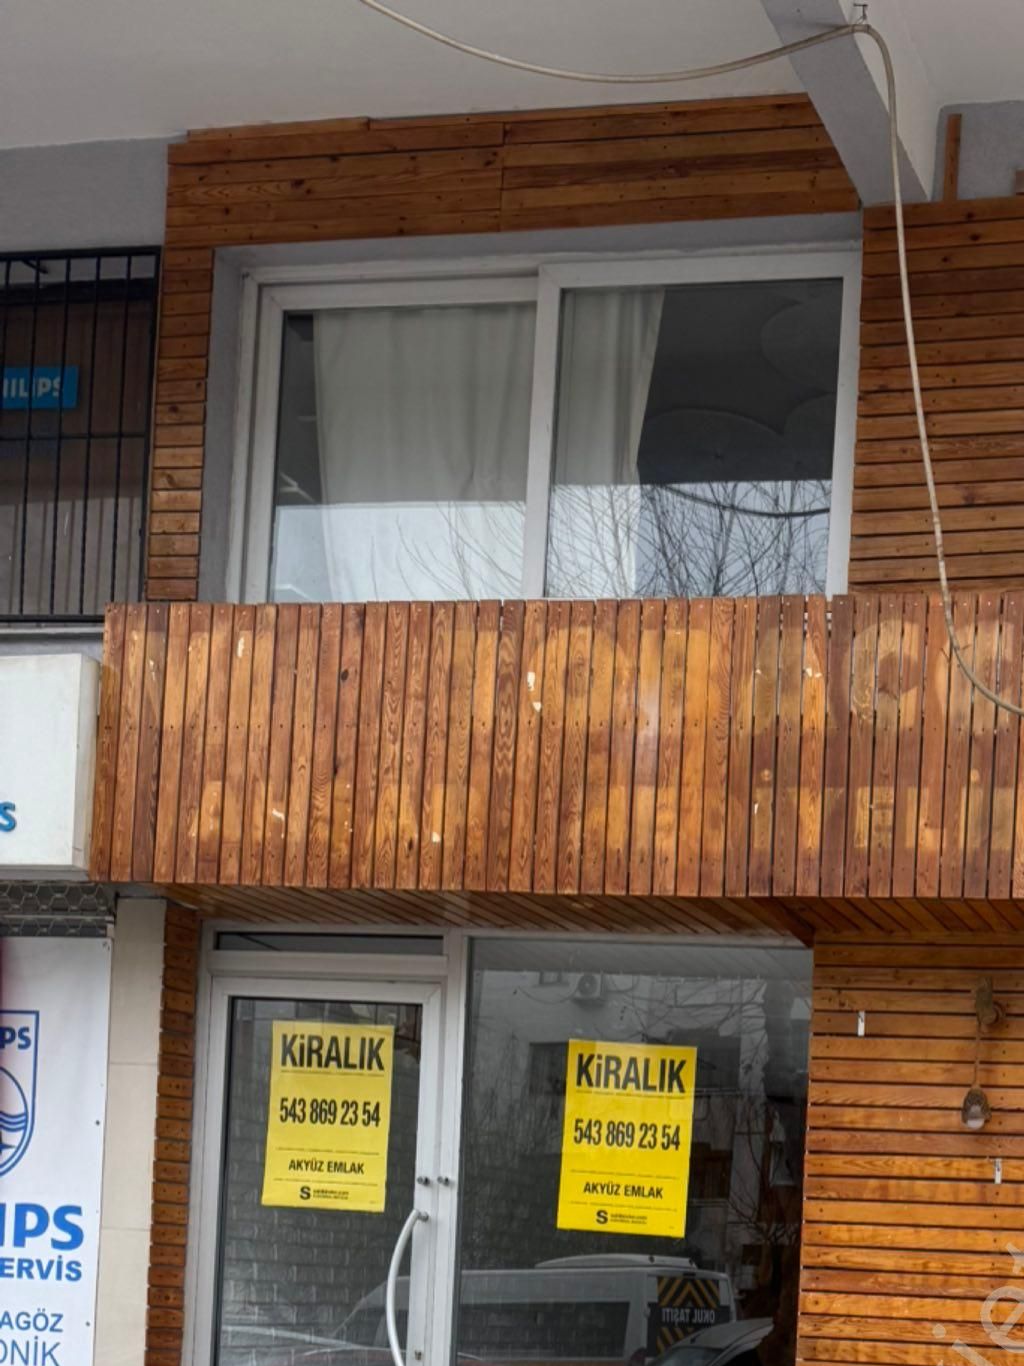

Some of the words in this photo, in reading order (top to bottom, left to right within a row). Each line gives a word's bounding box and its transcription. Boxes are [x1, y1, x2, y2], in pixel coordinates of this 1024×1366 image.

[280, 1097, 307, 1124] 543
[309, 1098, 338, 1125] 869
[340, 1100, 359, 1126] 23
[362, 1101, 381, 1127] 54
[574, 1118, 602, 1145] 543
[606, 1120, 636, 1148] 869
[638, 1122, 658, 1150] 23
[661, 1124, 681, 1152] 54
[288, 1157, 324, 1173] AKYÜZ
[326, 1160, 365, 1175] EMLAK
[299, 1186, 311, 1200] S
[583, 1180, 621, 1196] AKYÜZ
[624, 1184, 664, 1200] EMLAK
[596, 1210, 609, 1225] S
[0, 1307, 64, 1333] AGÖZ
